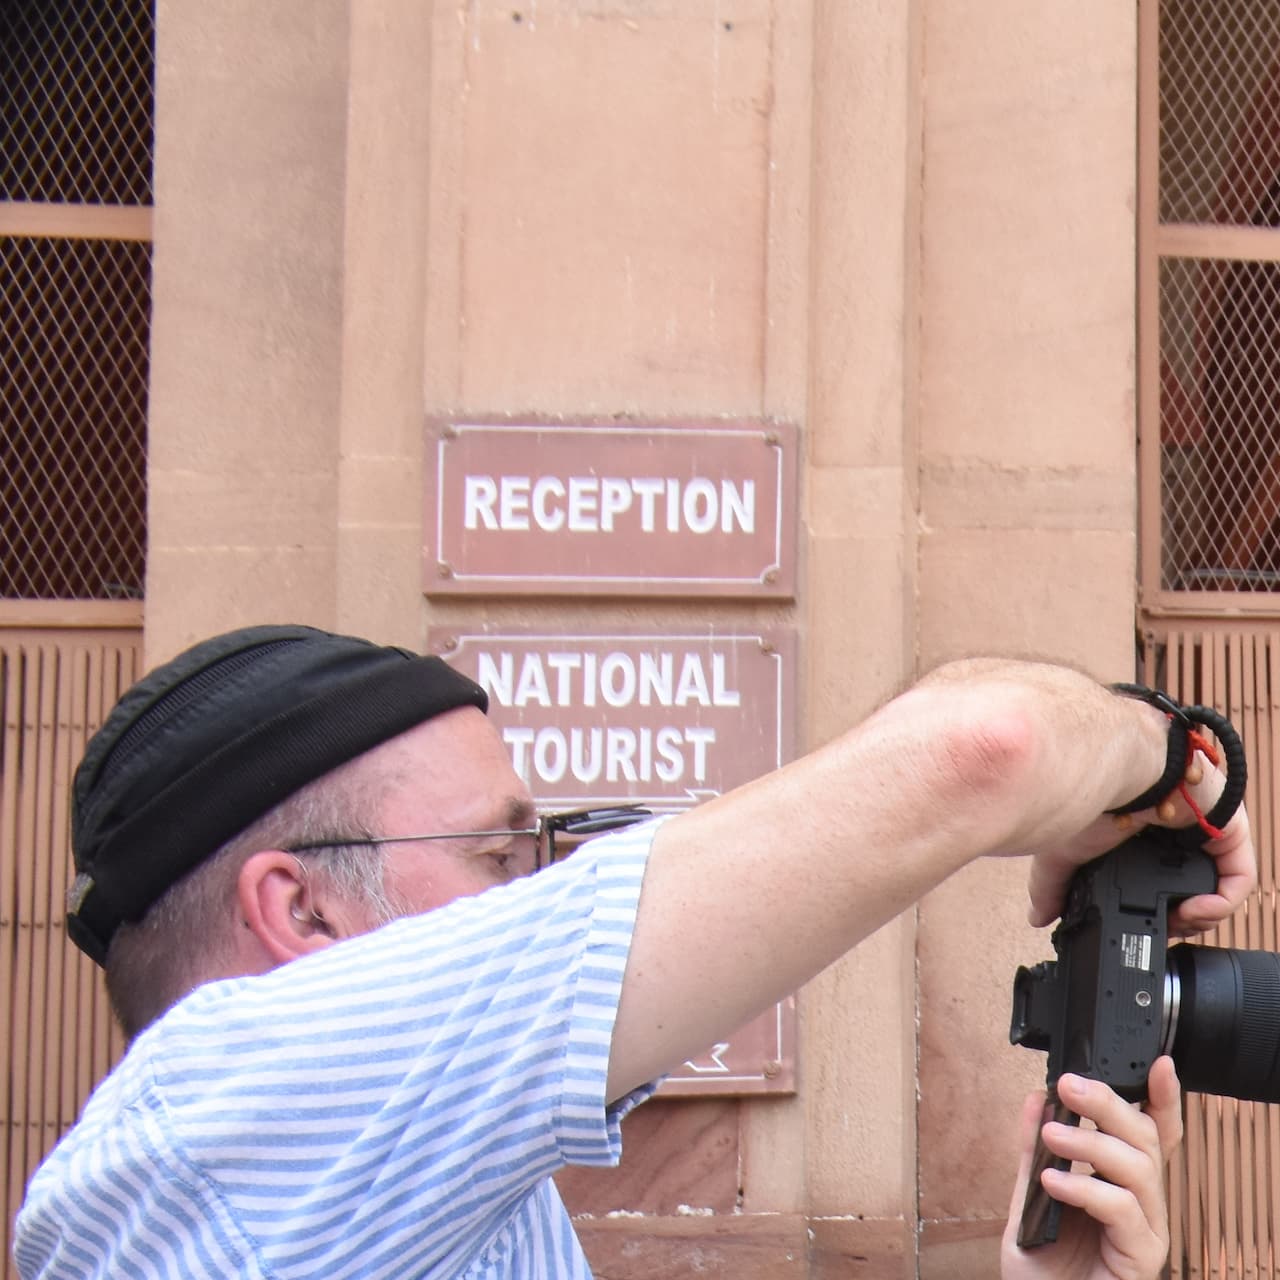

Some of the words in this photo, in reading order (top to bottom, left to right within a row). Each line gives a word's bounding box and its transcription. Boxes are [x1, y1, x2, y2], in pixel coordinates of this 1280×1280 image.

[464, 474, 755, 535] RECEPTION
[477, 651, 741, 708] NATIONAL
[502, 726, 717, 784] TOURIST
